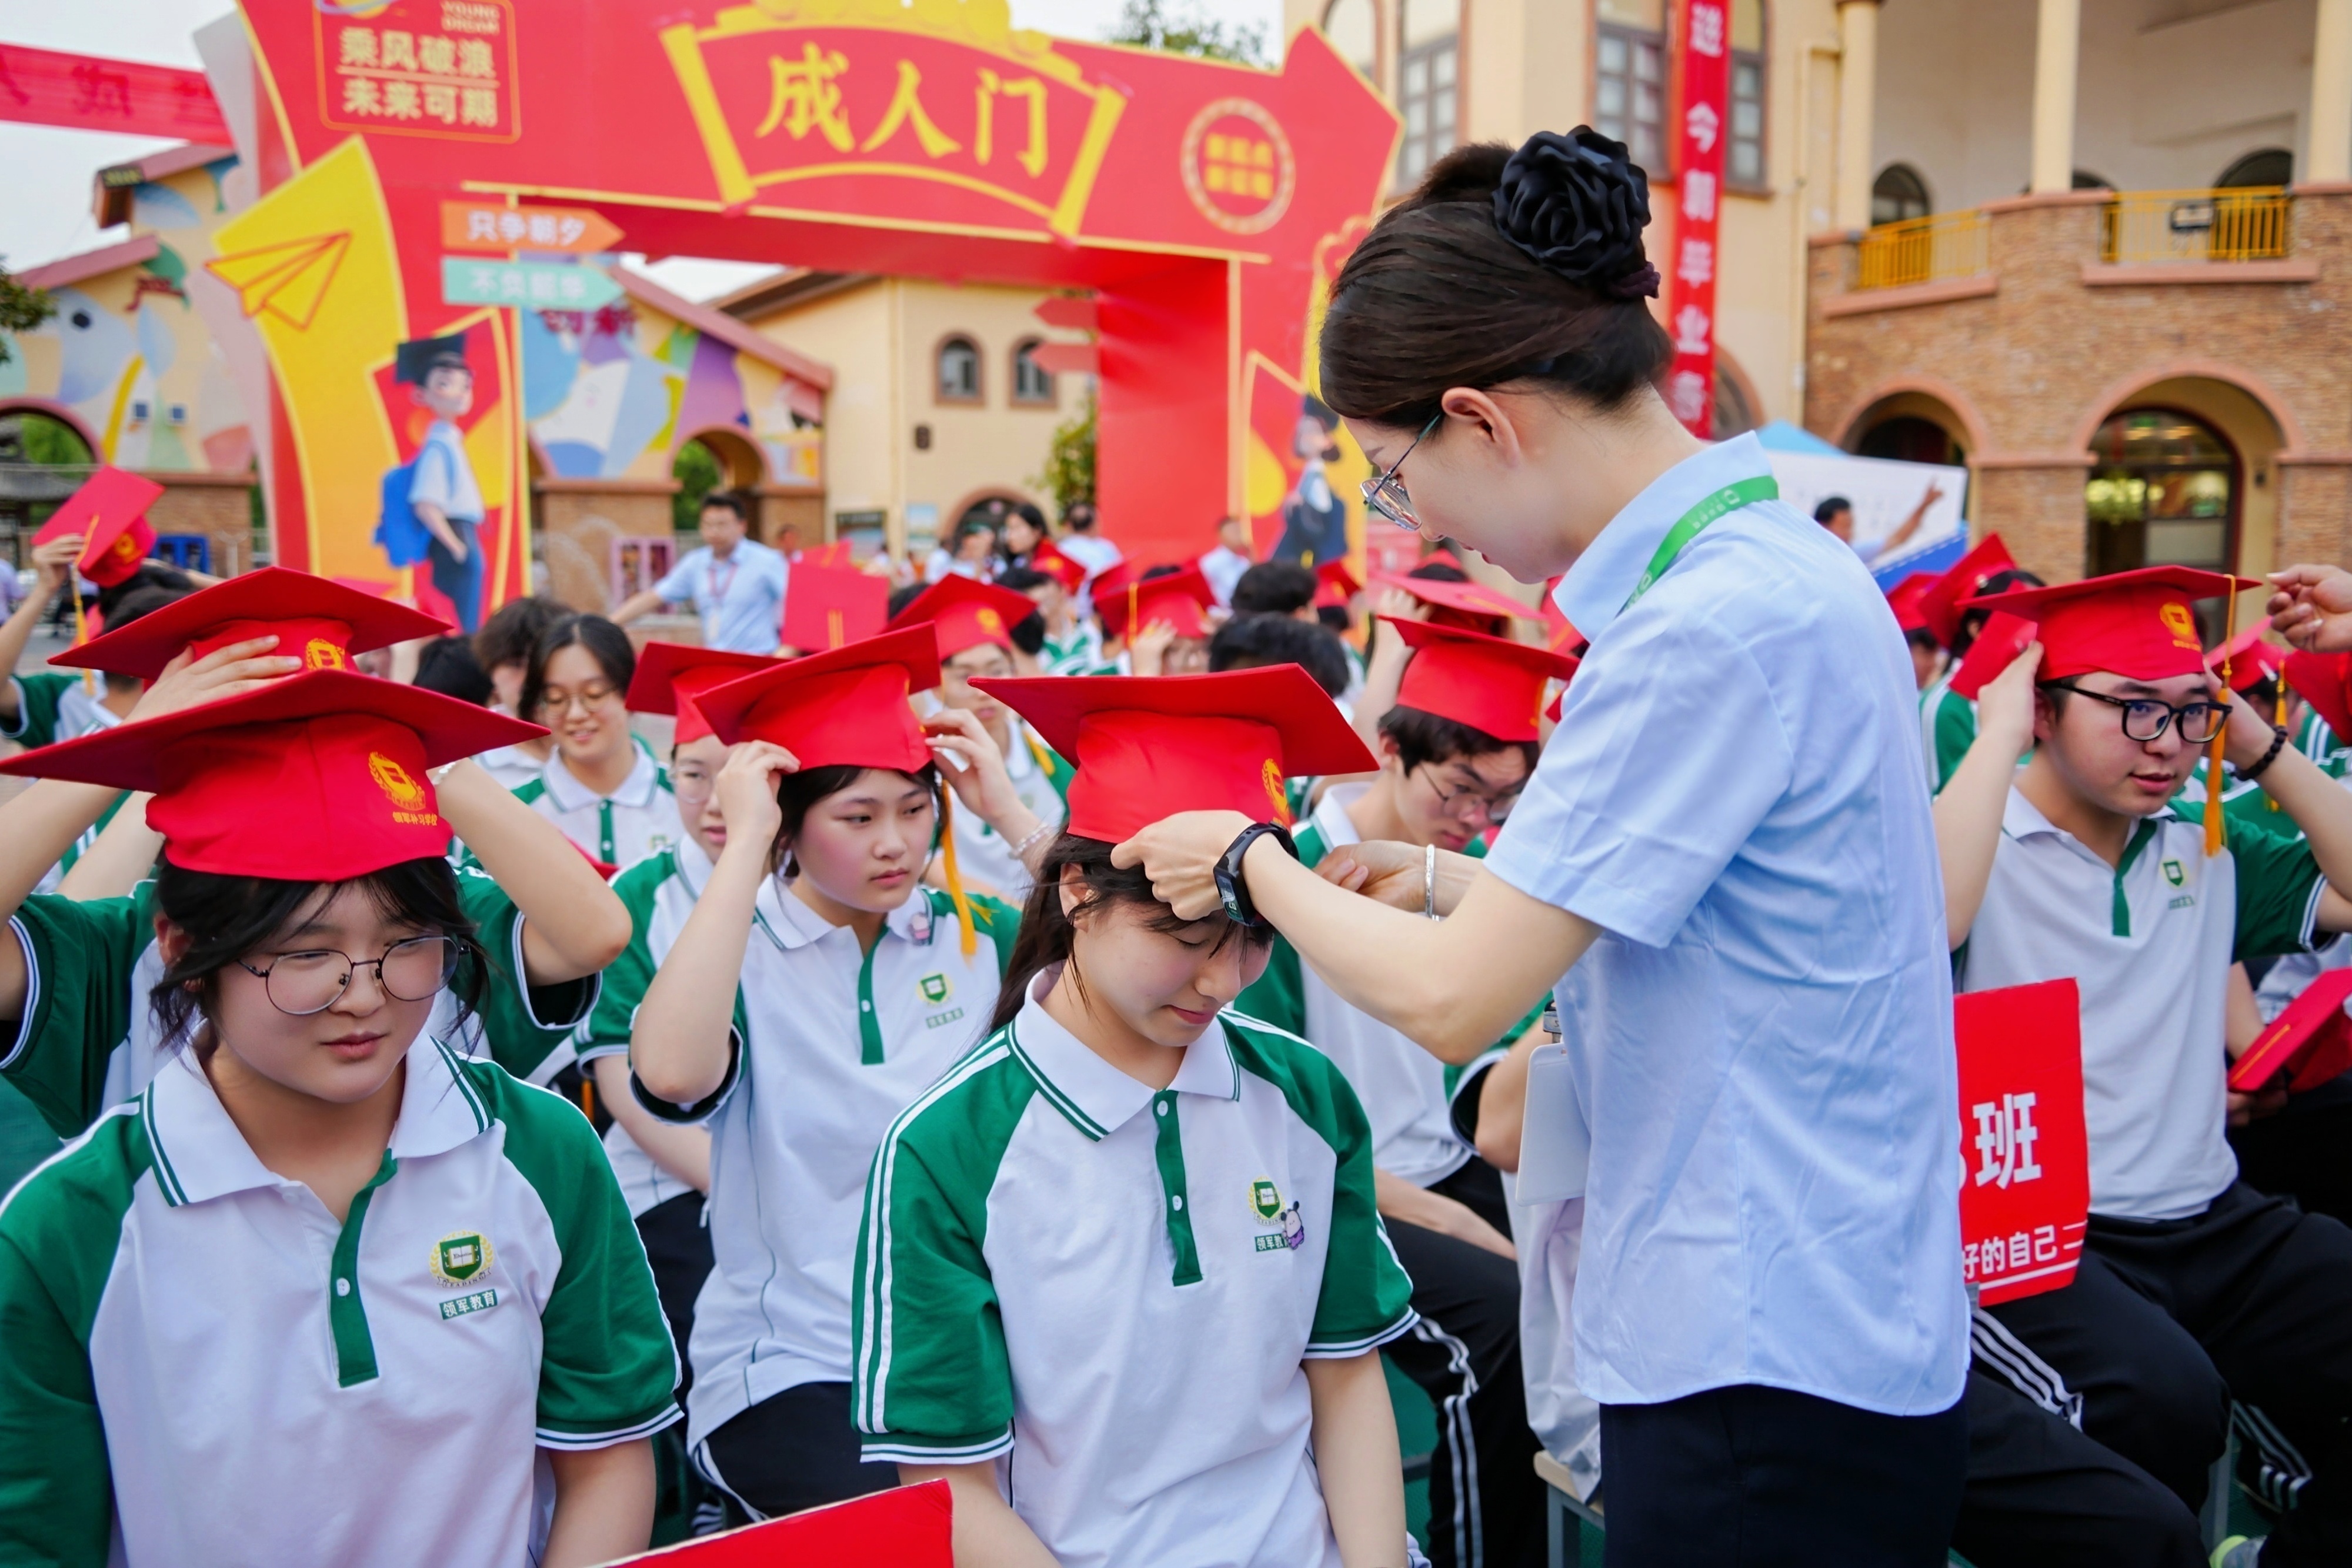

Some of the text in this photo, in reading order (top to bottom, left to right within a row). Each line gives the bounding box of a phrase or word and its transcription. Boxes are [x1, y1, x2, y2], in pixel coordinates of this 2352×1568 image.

[339, 26, 496, 78] 乘风破浪
[342, 76, 498, 128] 未来可期
[754, 40, 1048, 178] 成人门
[468, 210, 586, 246] 只争朝夕
[1959, 1092, 2042, 1190] 班
[1257, 1235, 1288, 1250] 领军教
[444, 1271, 485, 1288] LEADING
[443, 1291, 495, 1317] 领军教育
